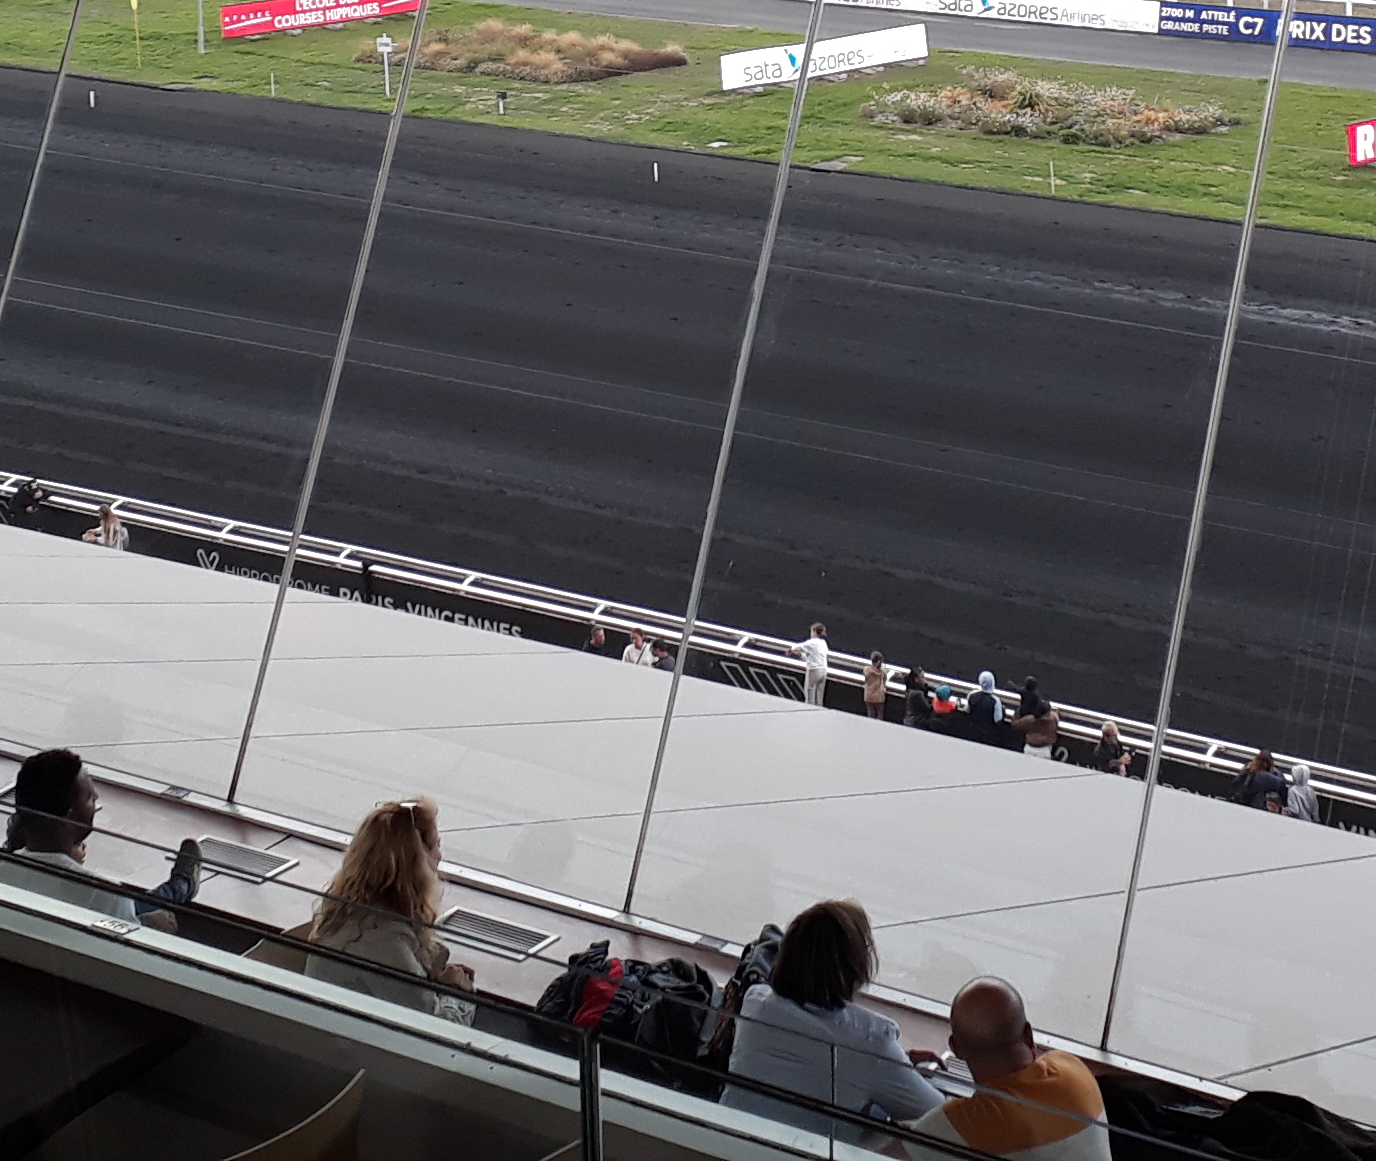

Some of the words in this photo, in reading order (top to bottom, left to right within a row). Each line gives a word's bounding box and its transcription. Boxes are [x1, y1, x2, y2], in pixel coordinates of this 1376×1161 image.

[274, 11, 324, 28] COURSES
[325, 2, 380, 22] HIPPIQUES
[1060, 8, 1105, 27] Airlines
[1161, 7, 1183, 19] 2700
[1185, 9, 1195, 19] M
[1200, 9, 1236, 22] ATTELÉ
[1160, 20, 1200, 33] GRANDE
[1202, 24, 1229, 35] PISTE
[1238, 16, 1263, 36] C7
[1276, 19, 1326, 41] PRIX
[1331, 26, 1372, 45] DES
[743, 61, 782, 82] sata
